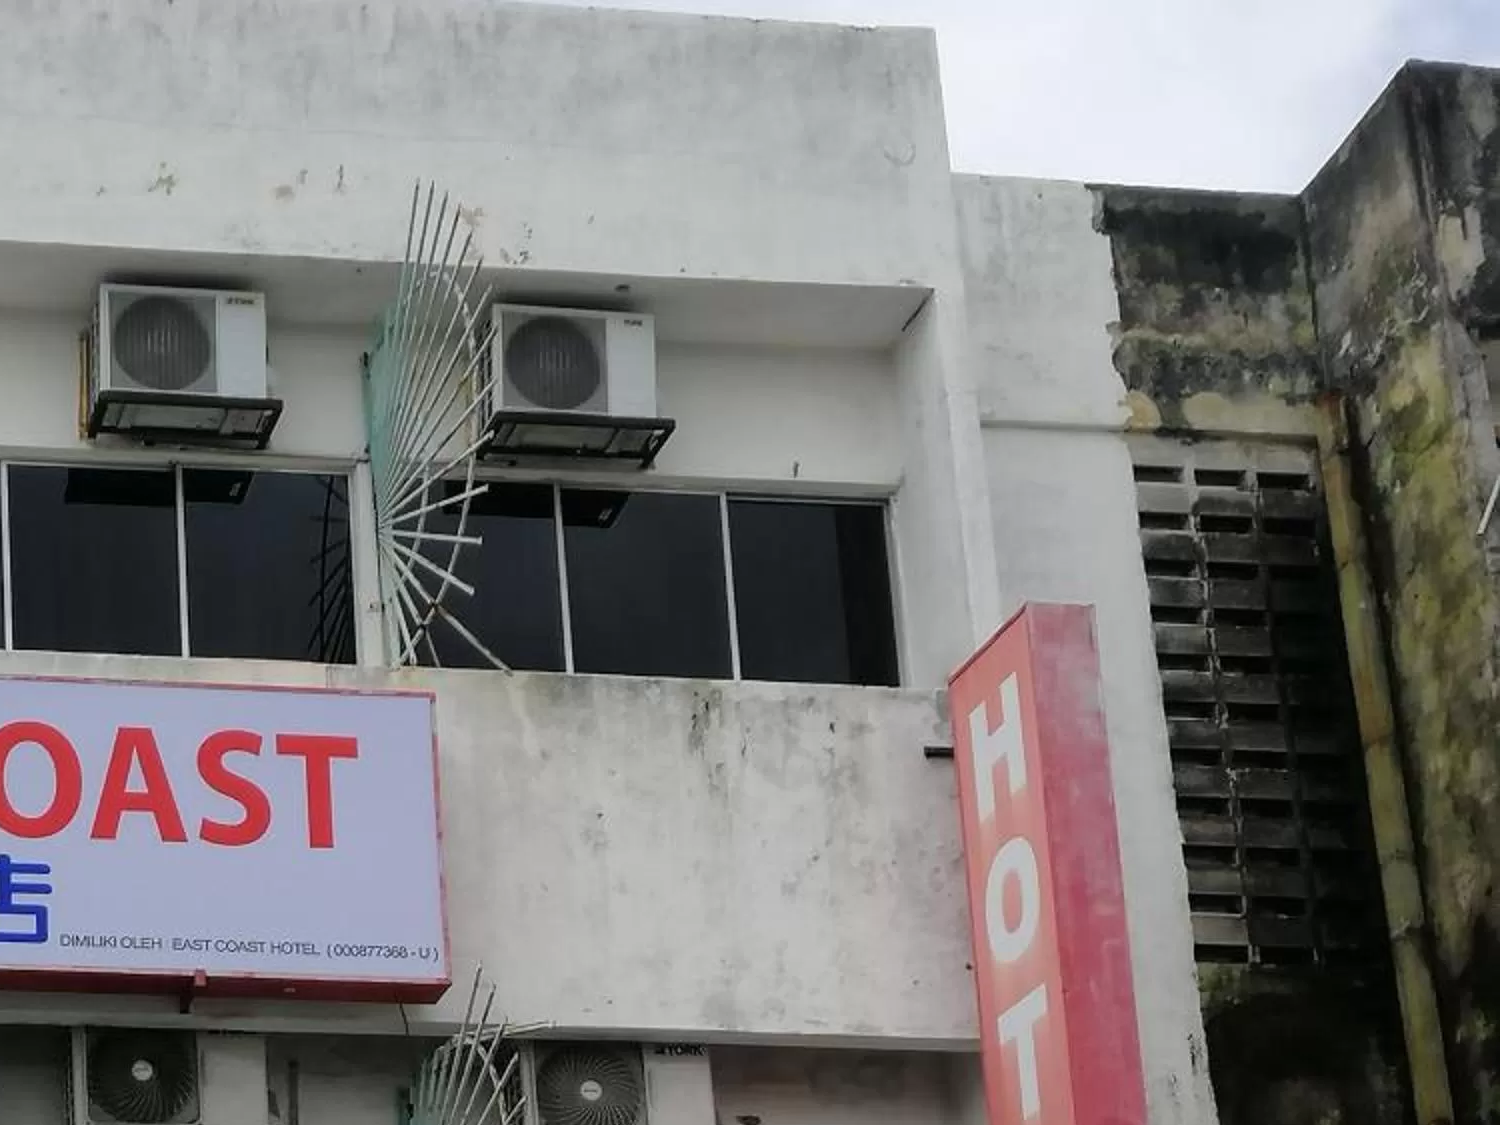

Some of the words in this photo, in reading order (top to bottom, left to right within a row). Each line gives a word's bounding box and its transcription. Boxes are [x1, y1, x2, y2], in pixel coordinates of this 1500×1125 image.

[60, 934, 117, 948] DIMILIKI
[173, 938, 212, 951] EAST
[214, 939, 266, 953] COAST
[271, 942, 320, 956] HOTEL
